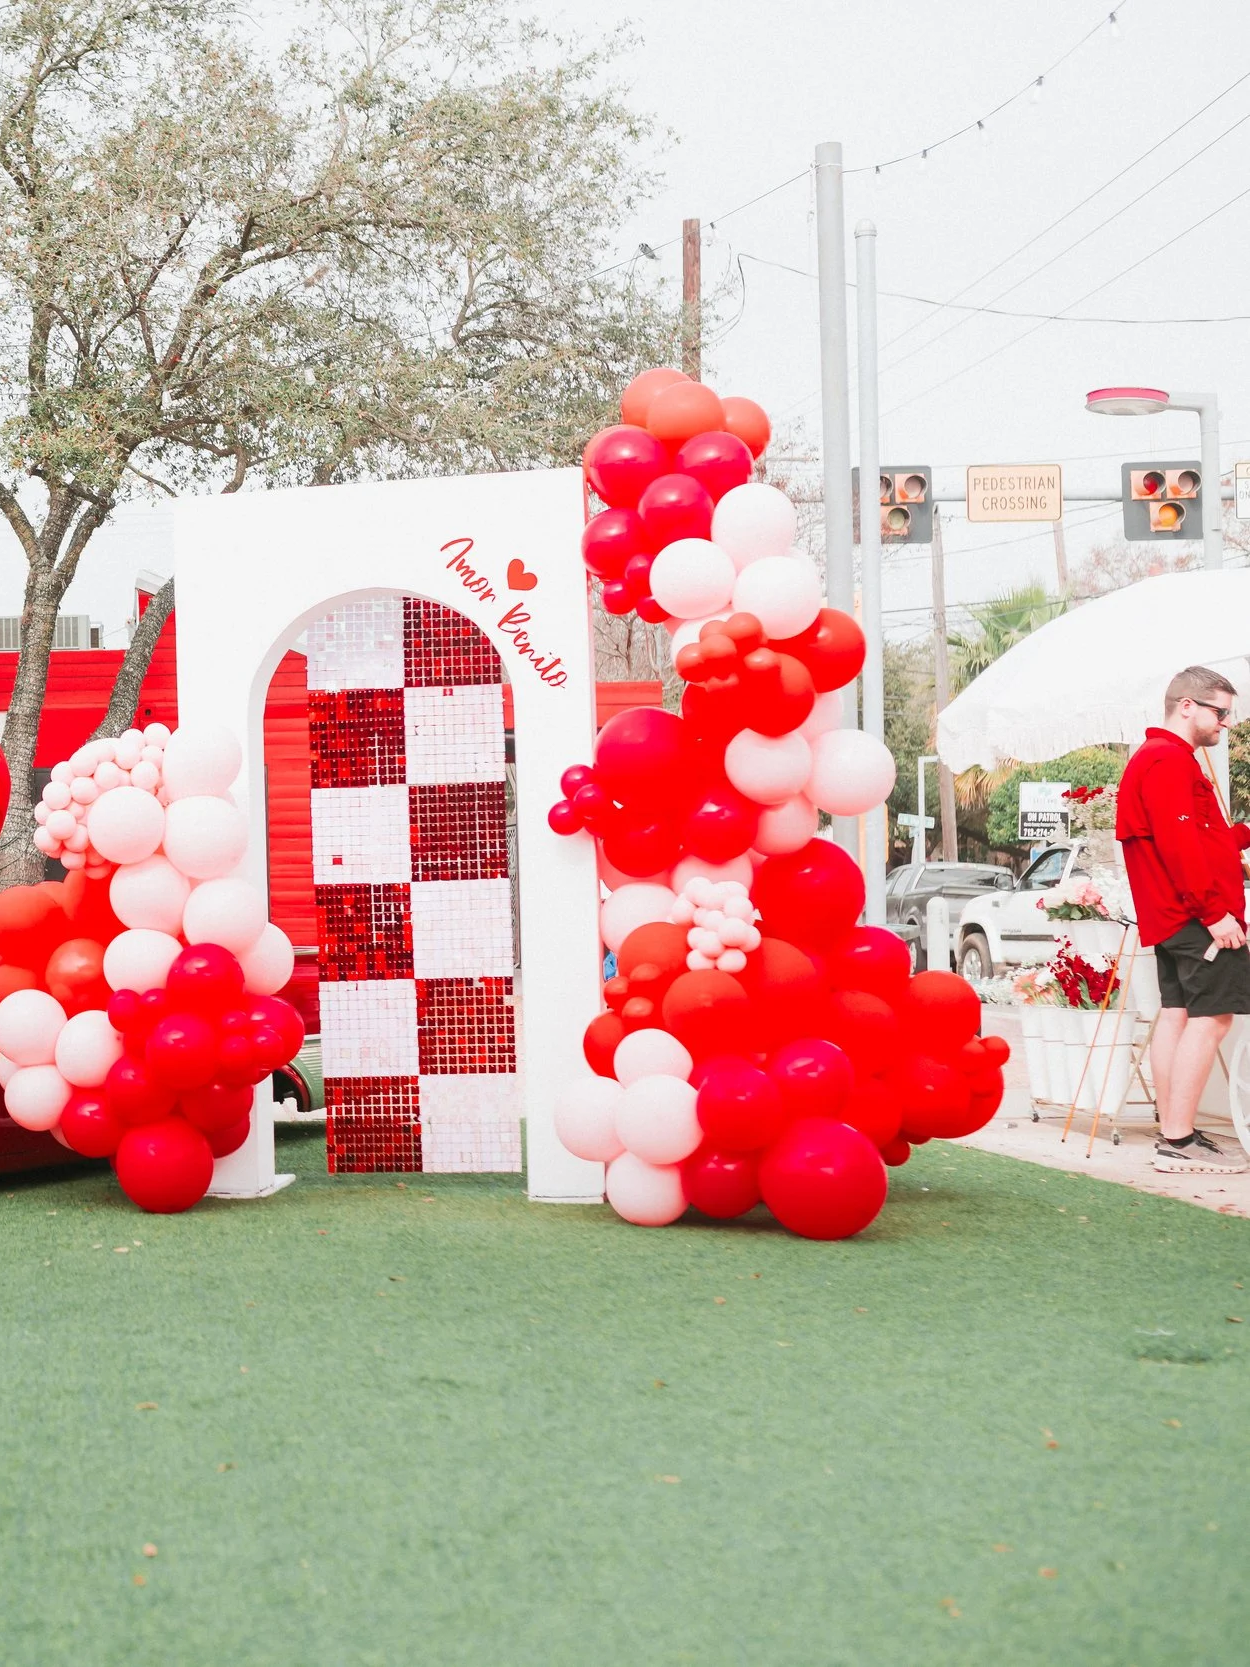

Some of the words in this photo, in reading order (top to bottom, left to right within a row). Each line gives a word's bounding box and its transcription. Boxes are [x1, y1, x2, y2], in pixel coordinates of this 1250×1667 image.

[973, 476, 1056, 491] PEDESTRIAN
[981, 495, 1048, 511] CROSSING
[439, 537, 496, 602] Amor
[497, 602, 568, 689] Benito
[1038, 812, 1062, 822] PATROL
